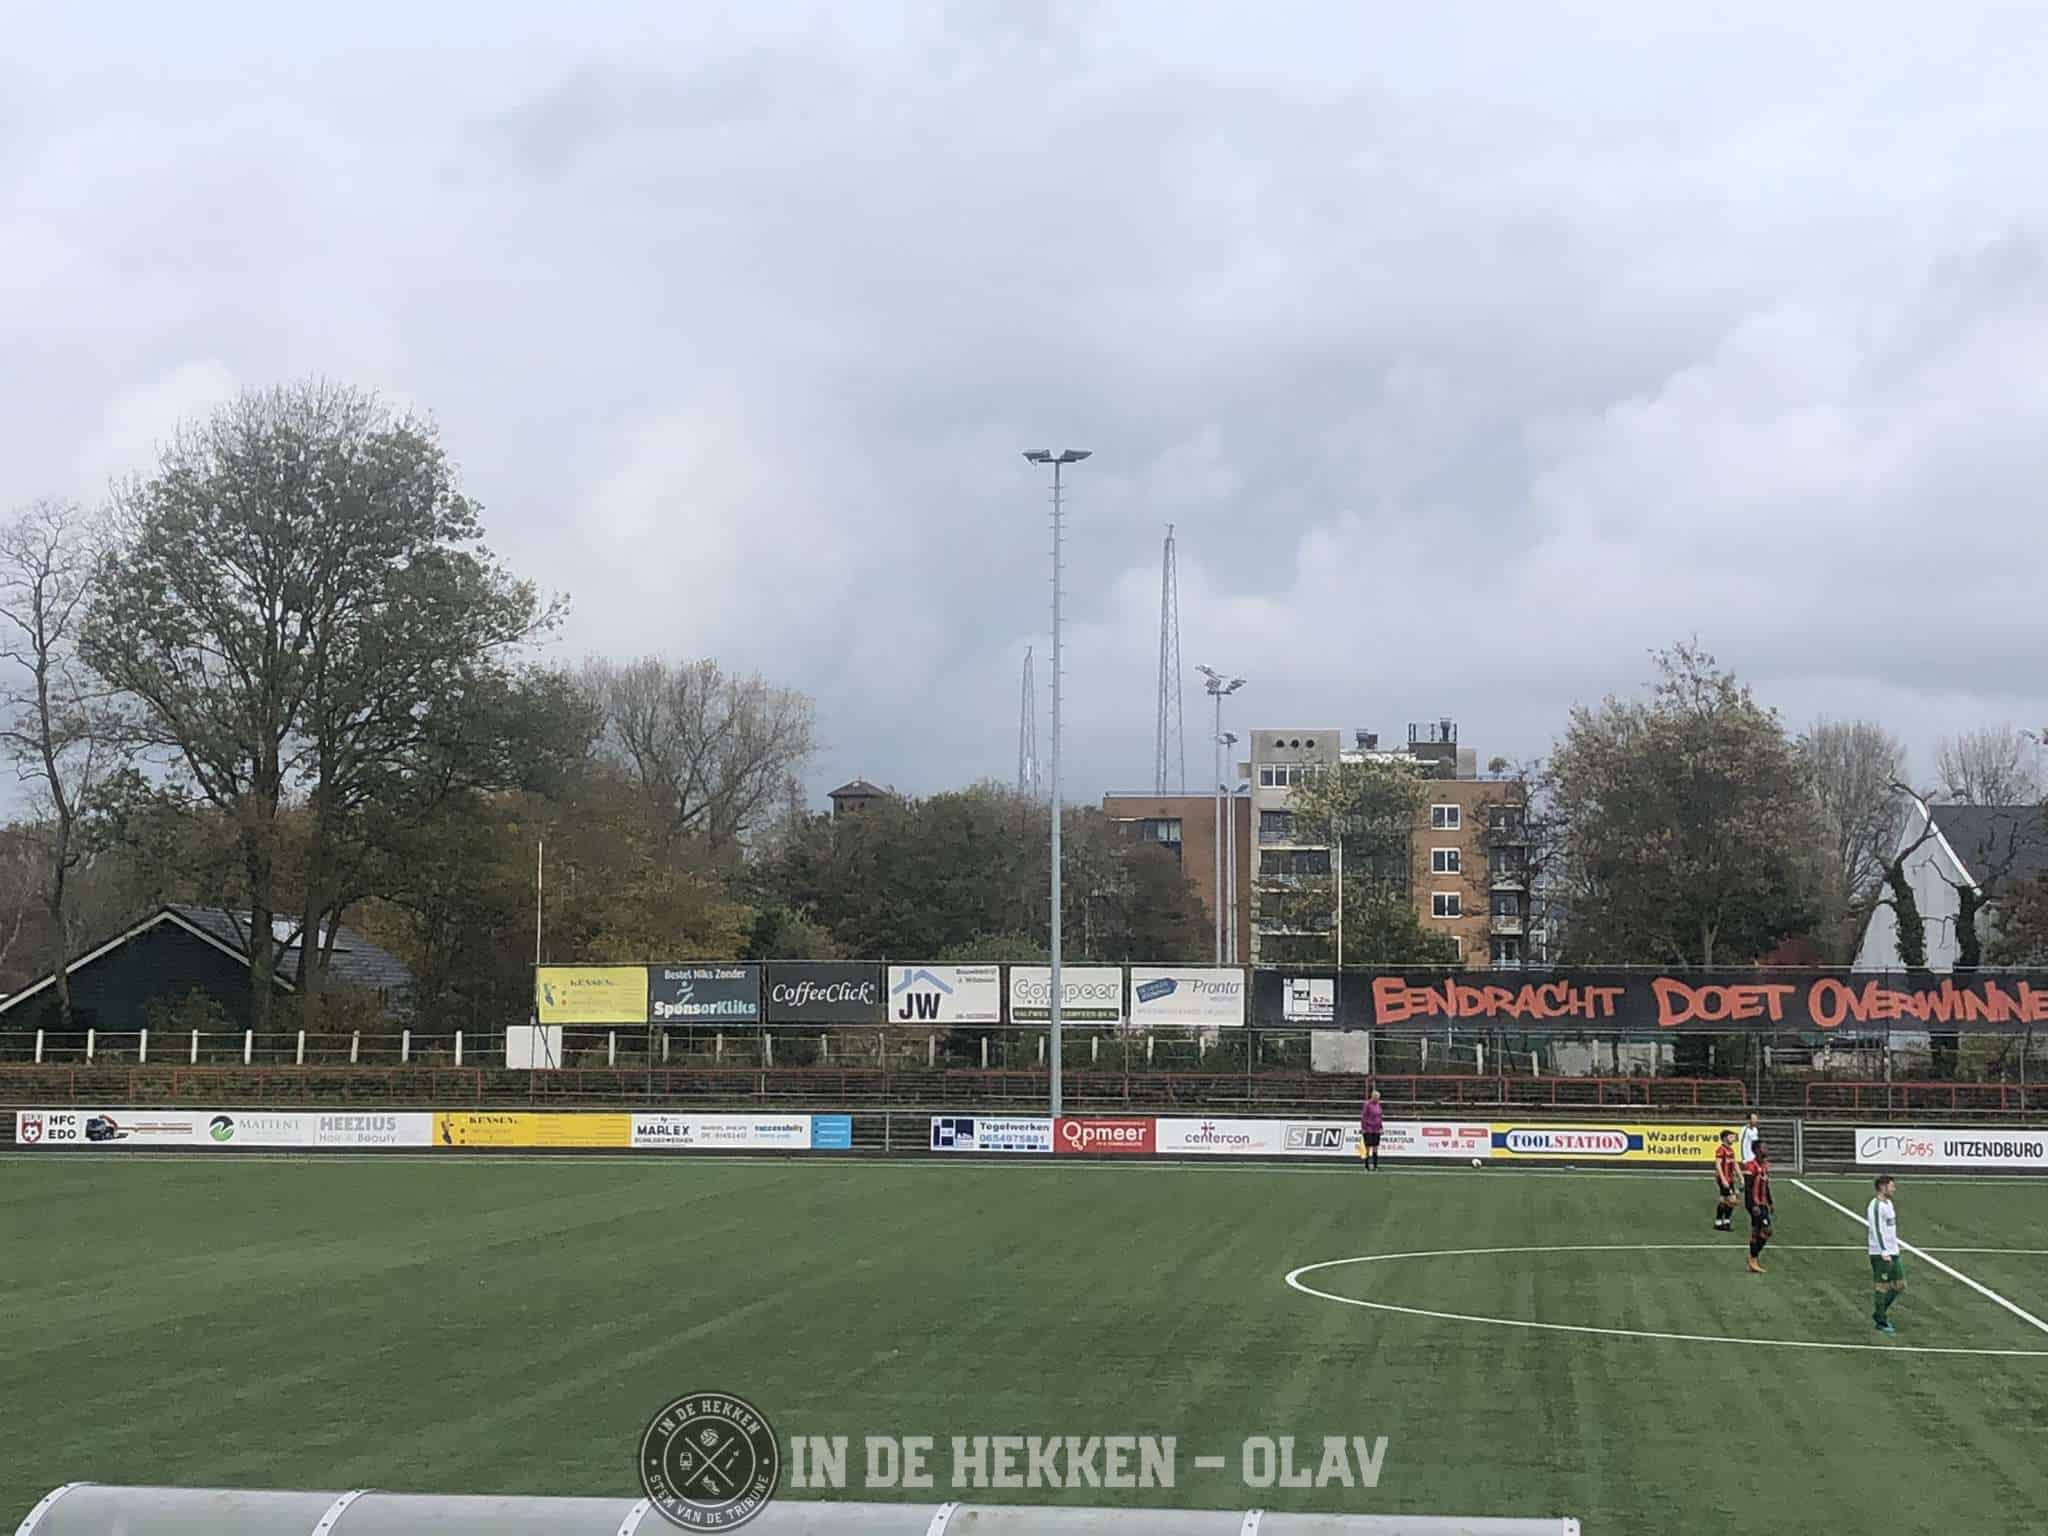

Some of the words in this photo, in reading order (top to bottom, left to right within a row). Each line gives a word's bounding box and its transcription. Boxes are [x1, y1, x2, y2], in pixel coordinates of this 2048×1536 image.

[899, 993, 941, 1019] JW
[1371, 976, 1624, 1025] EENDRACHT
[1651, 977, 1796, 1027] DOET
[654, 1000, 757, 1019] SponsorKliks
[49, 1115, 76, 1125] HFC
[320, 1117, 396, 1131] HEEZIUS
[48, 1129, 76, 1139] EDO
[637, 1125, 690, 1135] MARLEX
[1287, 1128, 1343, 1148] STN
[1511, 1135, 1624, 1149] TOOLSTATION
[1648, 1144, 1701, 1154] Haarlem
[1861, 1135, 1905, 1158] CITY
[1944, 1141, 2044, 1158] UITZENDBURO
